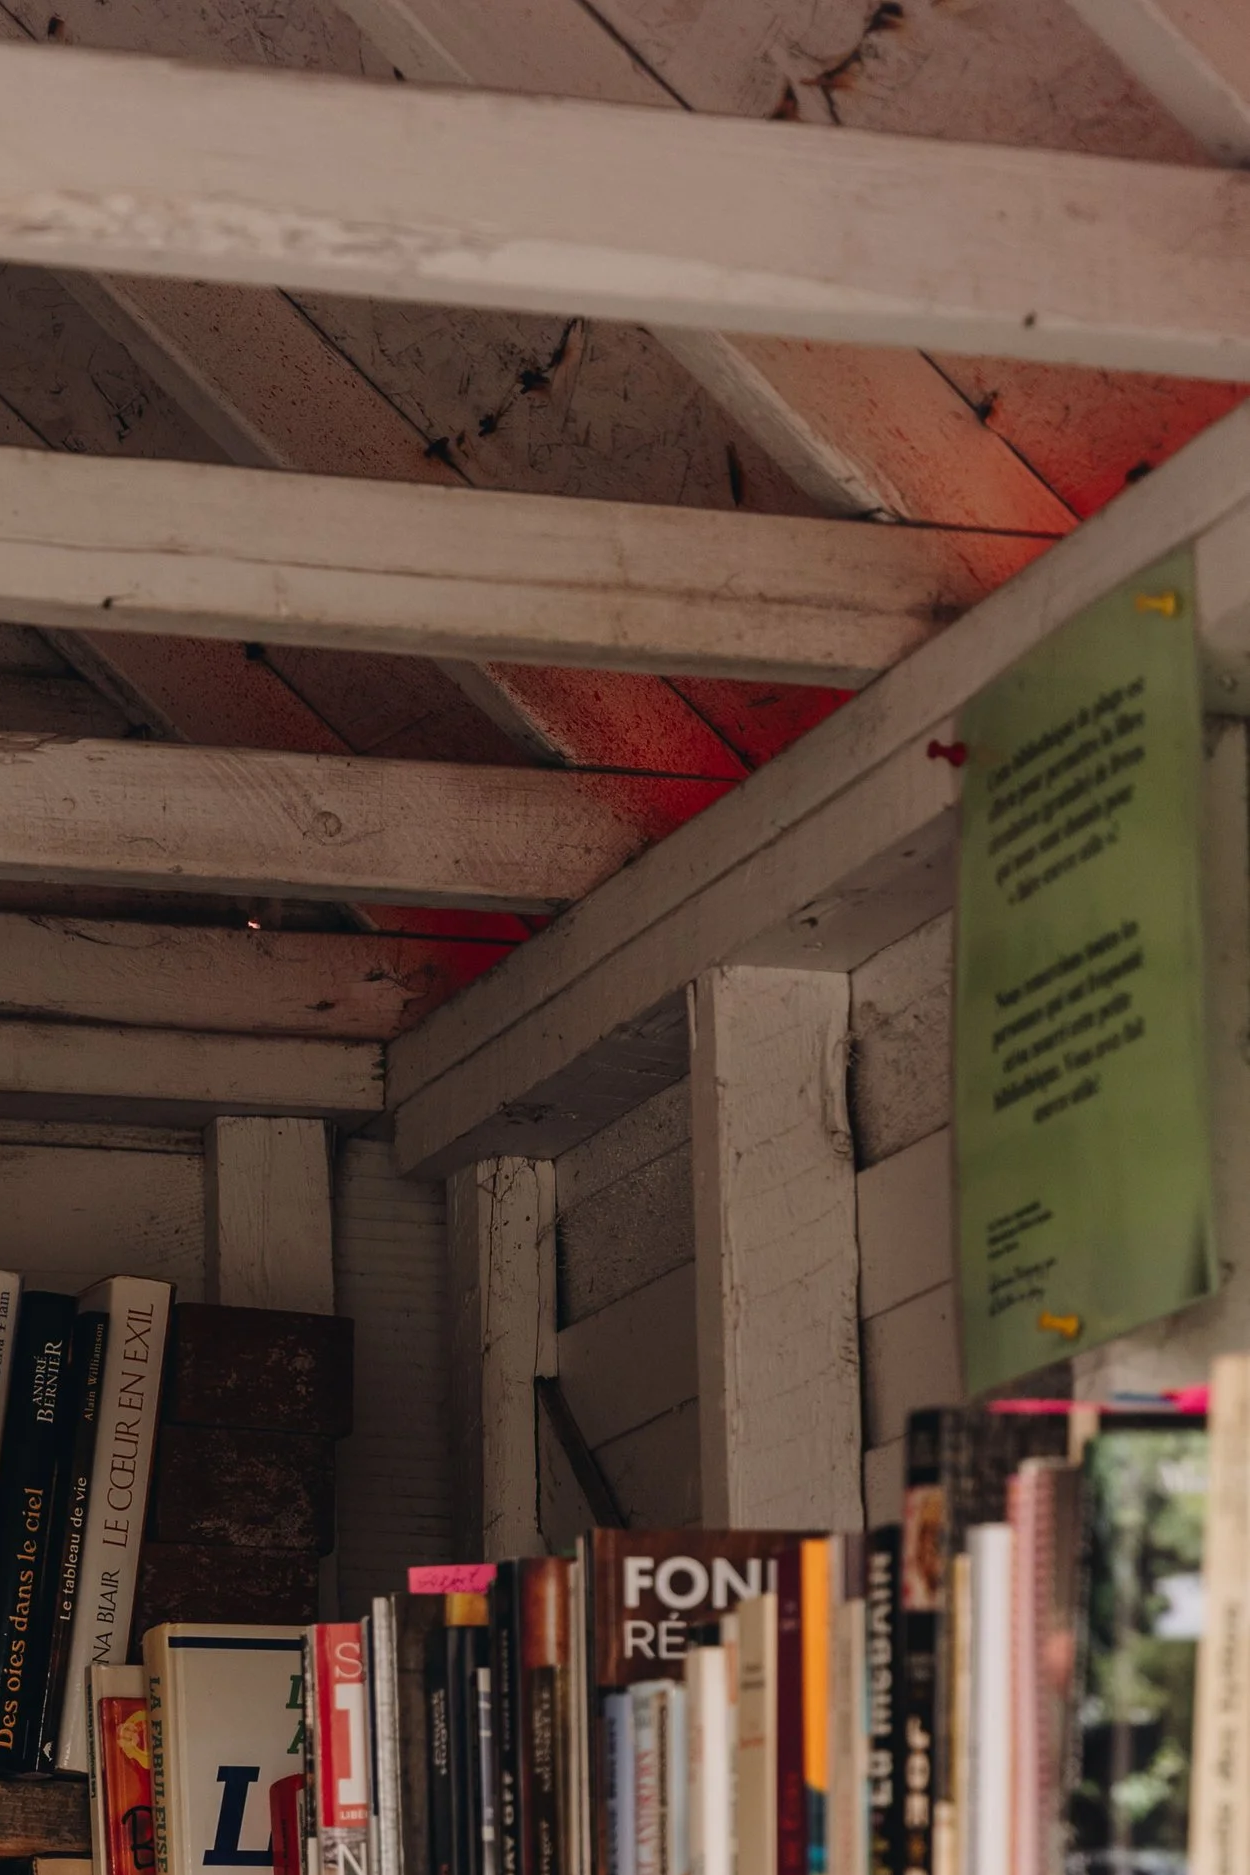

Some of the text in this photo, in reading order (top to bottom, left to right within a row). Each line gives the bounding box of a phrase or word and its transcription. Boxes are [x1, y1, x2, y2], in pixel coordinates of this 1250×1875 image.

[123, 1303, 154, 1364] EXIL
[32, 1355, 48, 1406] ANDRÉ
[36, 1340, 63, 1424] BERNIER
[83, 1323, 105, 1421] Alain Williamson
[118, 1371, 147, 1412] EN
[22, 1487, 44, 1532] ciel
[102, 1518, 130, 1548] LE
[16, 1538, 37, 1562] le
[59, 1476, 88, 1621] Le tableau de vie
[8, 1570, 34, 1633] dans
[97, 1569, 121, 1624] BLAIR
[622, 1556, 778, 1609] FON
[3, 1639, 26, 1691] oies
[149, 1676, 161, 1712] LA
[150, 1719, 169, 1874] FABULEUSE
